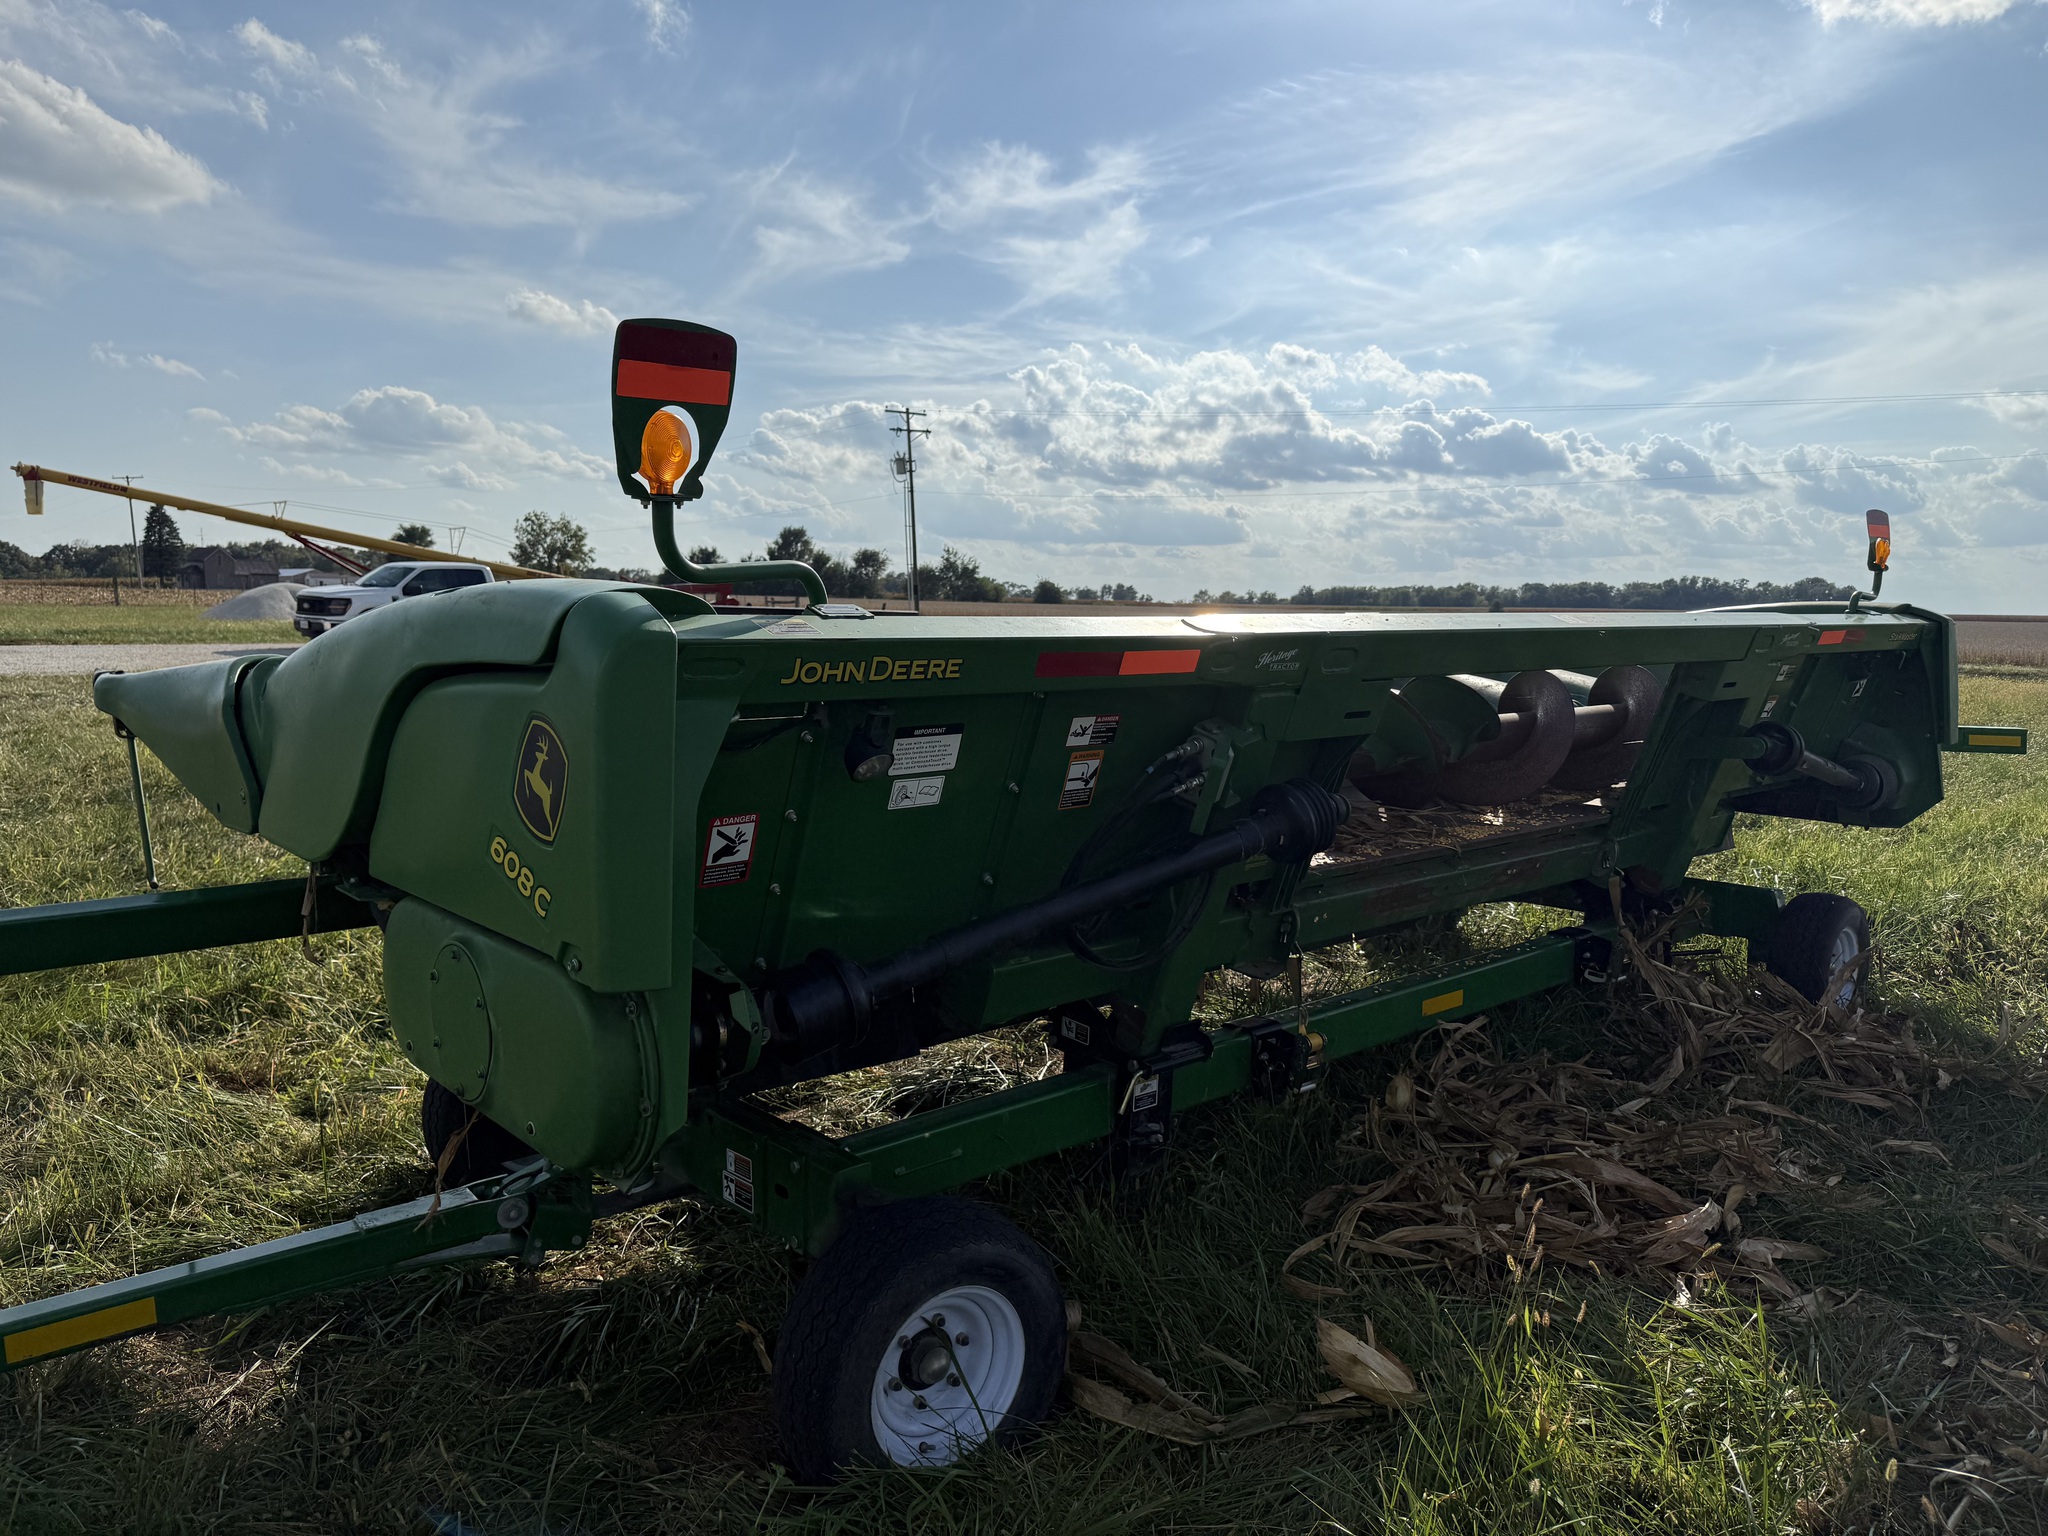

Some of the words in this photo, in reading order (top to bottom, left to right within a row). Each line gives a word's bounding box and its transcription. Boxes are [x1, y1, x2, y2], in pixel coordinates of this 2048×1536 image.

[67, 475, 120, 491] WESTFIELD
[1254, 648, 1299, 669] Heritage
[780, 657, 866, 684] JOHN
[869, 656, 964, 681] DEERE
[913, 727, 947, 736] IMPORTANT
[722, 814, 757, 825] DANGER
[490, 835, 552, 919] 608C
